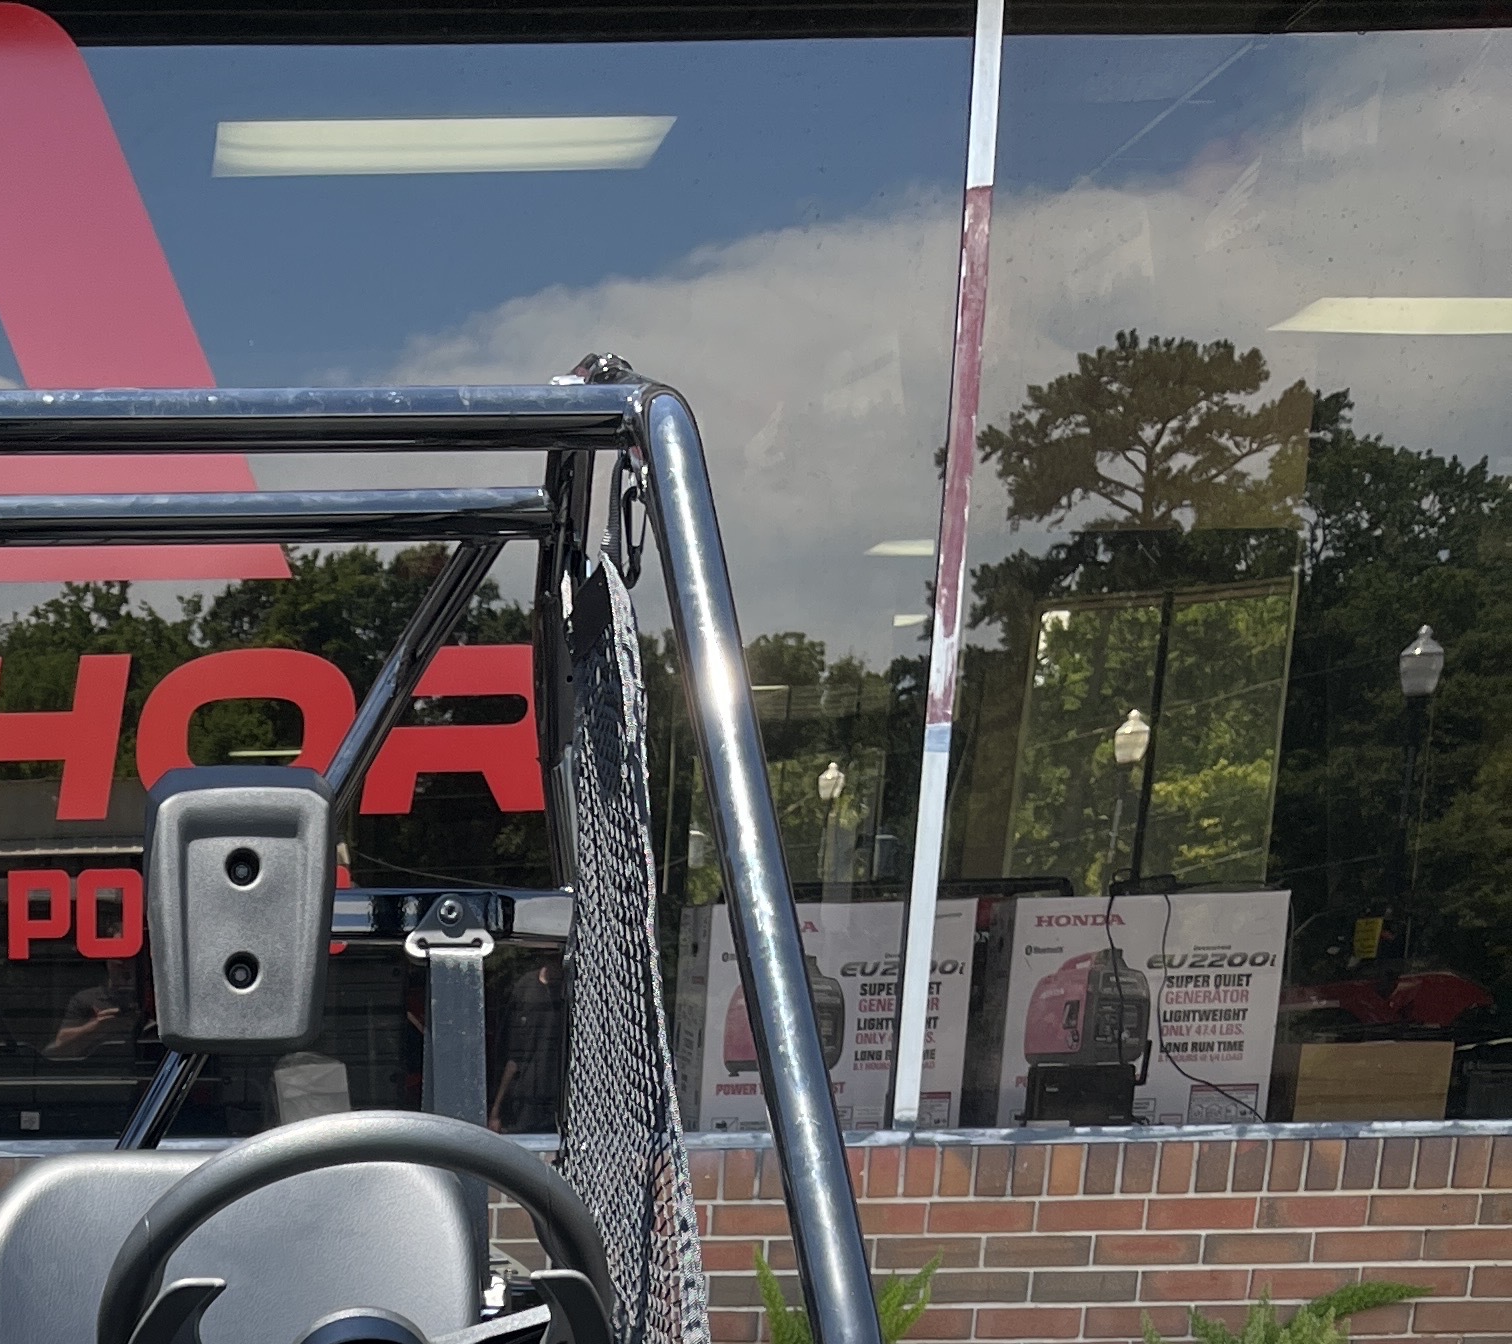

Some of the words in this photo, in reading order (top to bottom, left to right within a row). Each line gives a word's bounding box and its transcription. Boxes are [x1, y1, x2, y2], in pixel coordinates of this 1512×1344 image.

[1034, 914, 1126, 927] HONDA
[1147, 951, 1277, 969] EU2200i
[1166, 974, 1210, 988] SUPER
[1213, 973, 1252, 989] QUIET
[859, 982, 897, 996] SUPE
[1165, 988, 1250, 1005] GENERATOR
[1162, 1008, 1249, 1023] LIGHTWEIGHT
[1162, 1024, 1193, 1037] ONLY
[855, 1032, 886, 1045] ONLY
[1160, 1041, 1189, 1054] LONG
[1191, 1041, 1215, 1053] RUN
[1217, 1040, 1245, 1052] TIME
[854, 1049, 883, 1062] LONG
[715, 1082, 757, 1096] POWER
